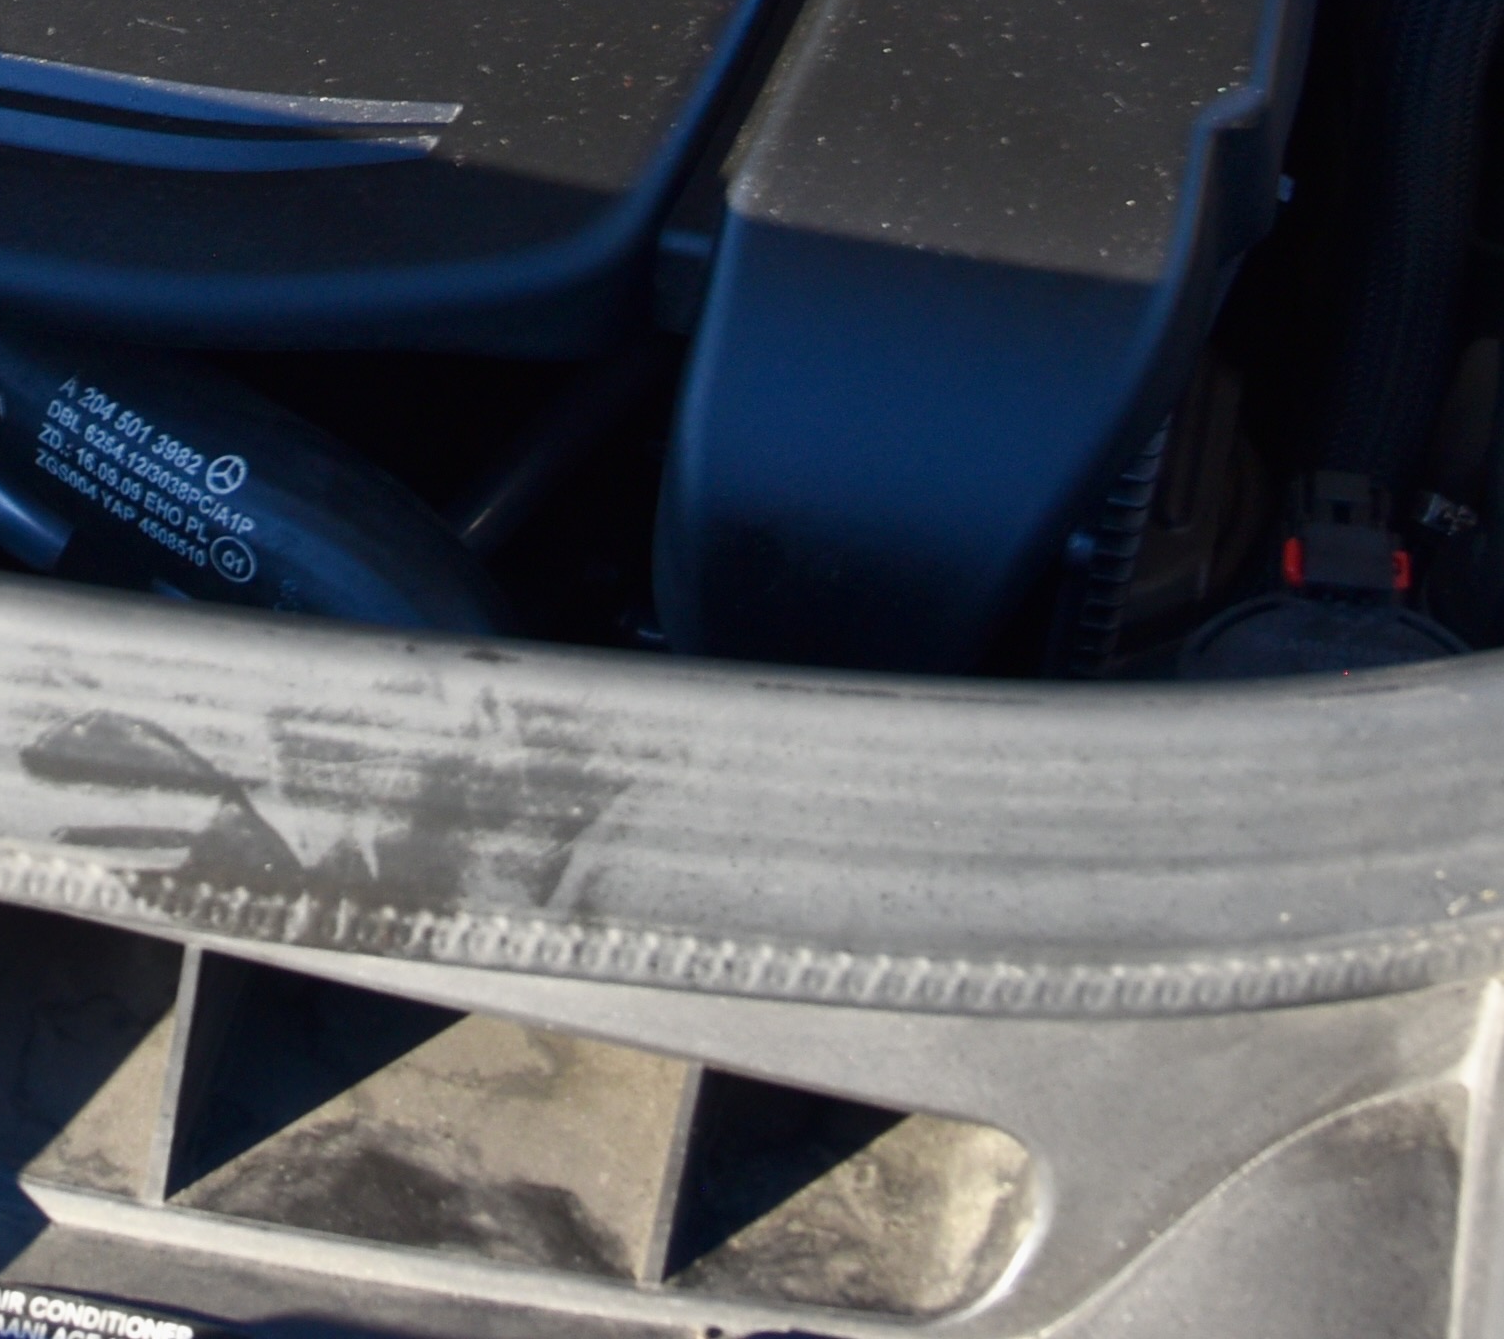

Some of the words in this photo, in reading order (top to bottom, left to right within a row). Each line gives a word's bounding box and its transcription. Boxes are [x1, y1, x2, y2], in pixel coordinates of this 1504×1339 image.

[47, 399, 81, 434] DBL
[59, 376, 78, 399] A
[78, 387, 118, 421] 204
[114, 410, 154, 443] 501
[151, 434, 203, 475] 3982
[76, 447, 141, 502] 16.09.09
[143, 491, 183, 525] EHO
[185, 516, 210, 544] PL
